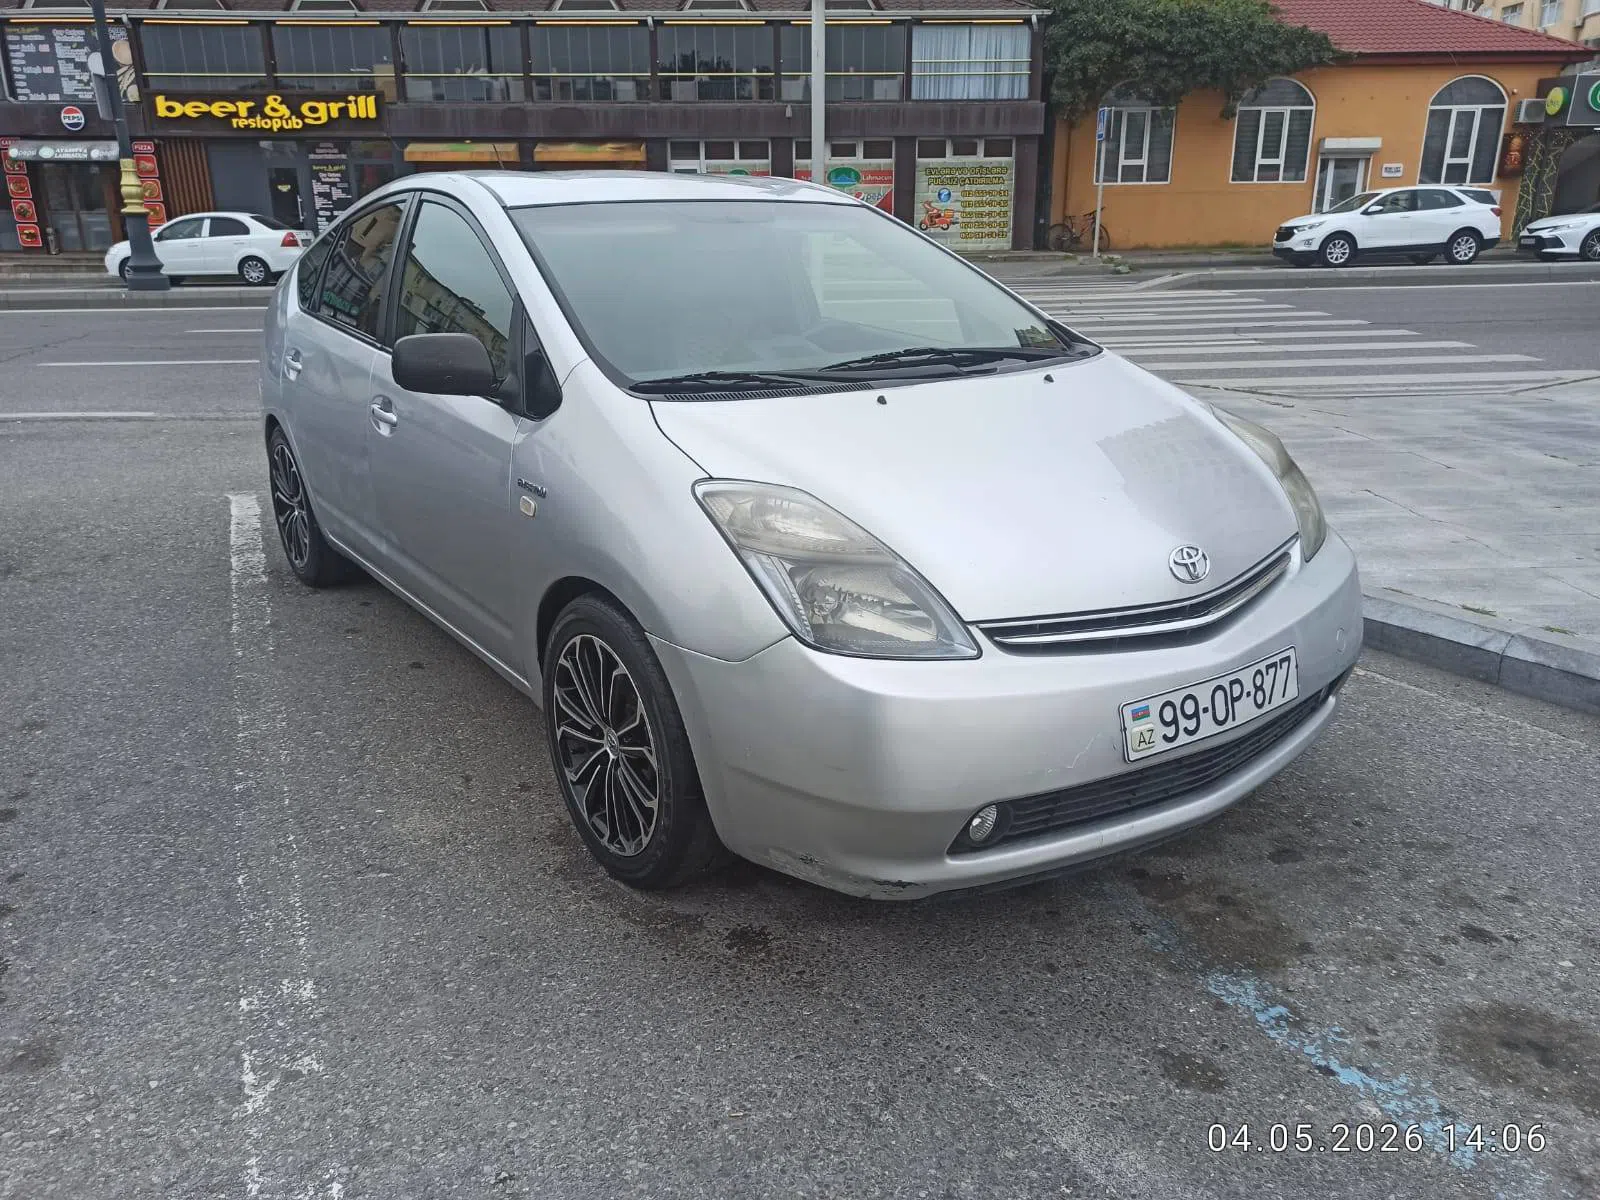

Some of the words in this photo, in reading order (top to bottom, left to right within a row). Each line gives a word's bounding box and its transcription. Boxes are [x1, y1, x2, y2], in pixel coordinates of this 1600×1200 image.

[155, 95, 255, 118] beer
[263, 95, 291, 118] &
[300, 95, 376, 125] grill
[232, 113, 303, 132] restopub
[928, 177, 958, 185] PULSUZ
[1158, 655, 1291, 743] 99-OP-877
[1137, 729, 1155, 748] AZ
